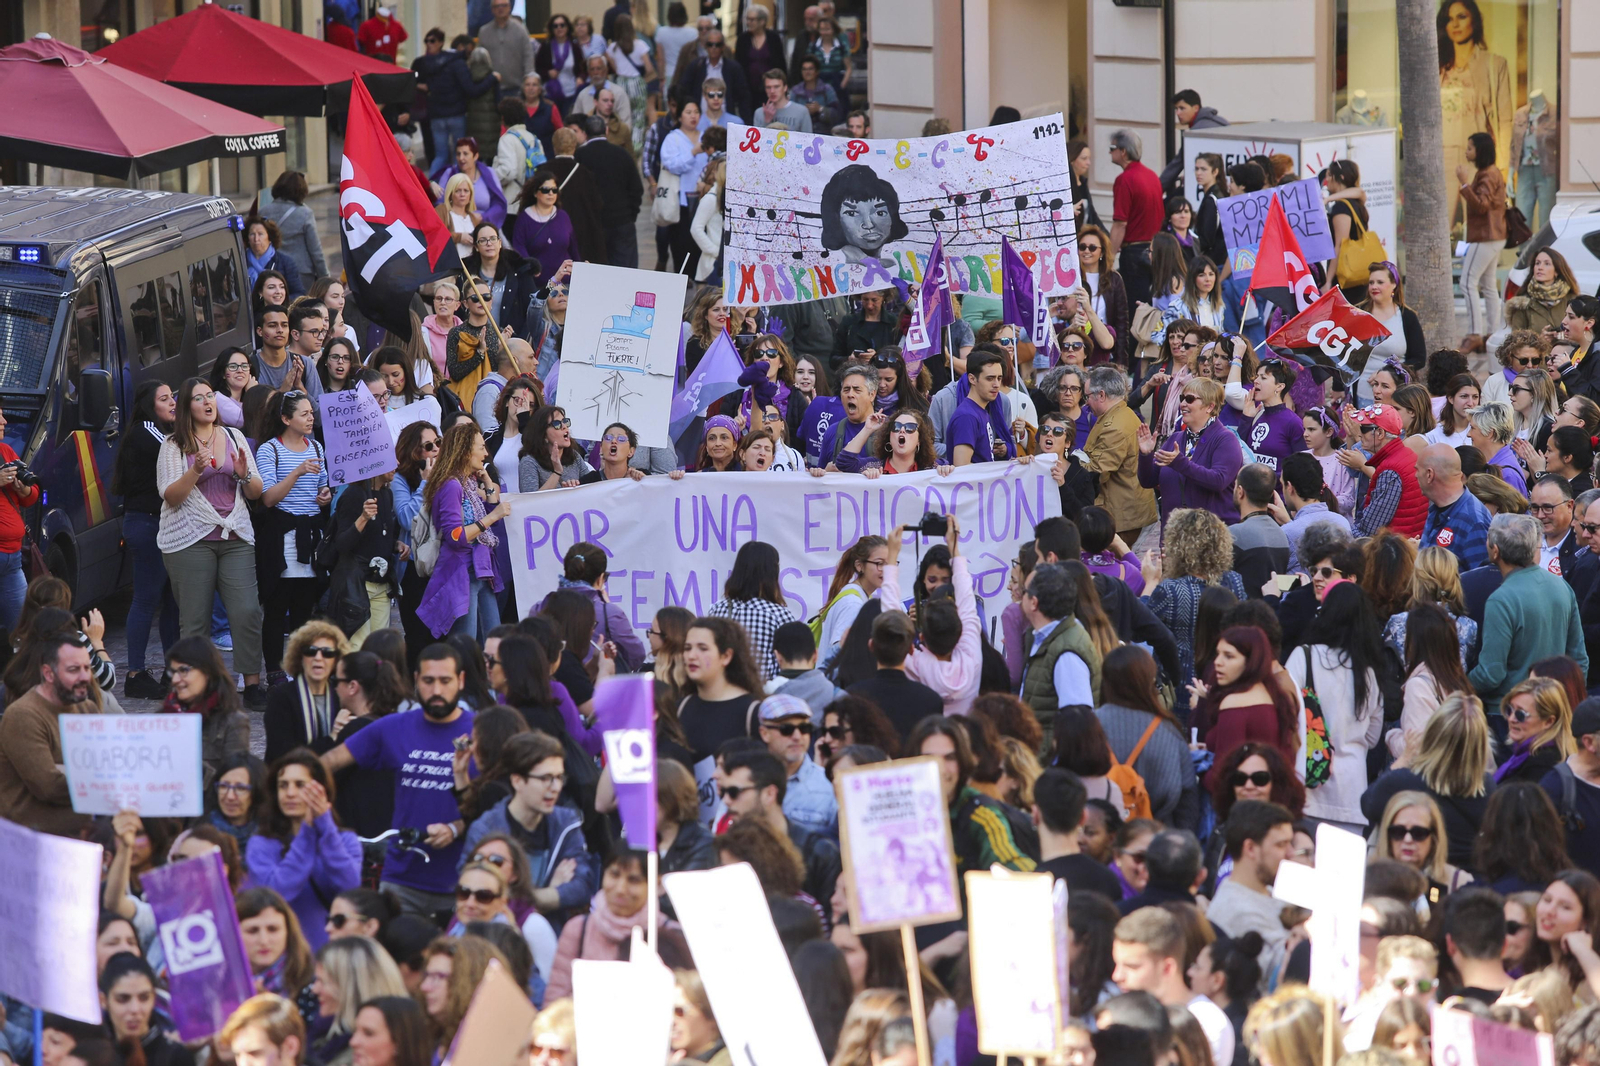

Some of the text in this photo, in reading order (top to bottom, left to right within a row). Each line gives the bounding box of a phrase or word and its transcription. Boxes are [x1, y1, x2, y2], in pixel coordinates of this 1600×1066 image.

[224, 133, 280, 153] COSTA COFFEE
[1227, 183, 1311, 224] POR MI
[1232, 208, 1324, 248] MARE
[859, 256, 892, 287] A
[962, 247, 1077, 295] REPEC
[1306, 320, 1364, 368] CGT
[333, 409, 379, 429] LUCHANDO
[820, 411, 834, 421] CGT
[343, 420, 382, 439] TAMBIÉN
[349, 435, 371, 448] ESTÁ
[334, 442, 389, 465] ENSEÑANDO
[523, 462, 1045, 570] POR UNA EDUCACIÓN
[66, 720, 83, 733] NO
[116, 717, 181, 733] FELICITES
[71, 744, 174, 772] COLABORA
